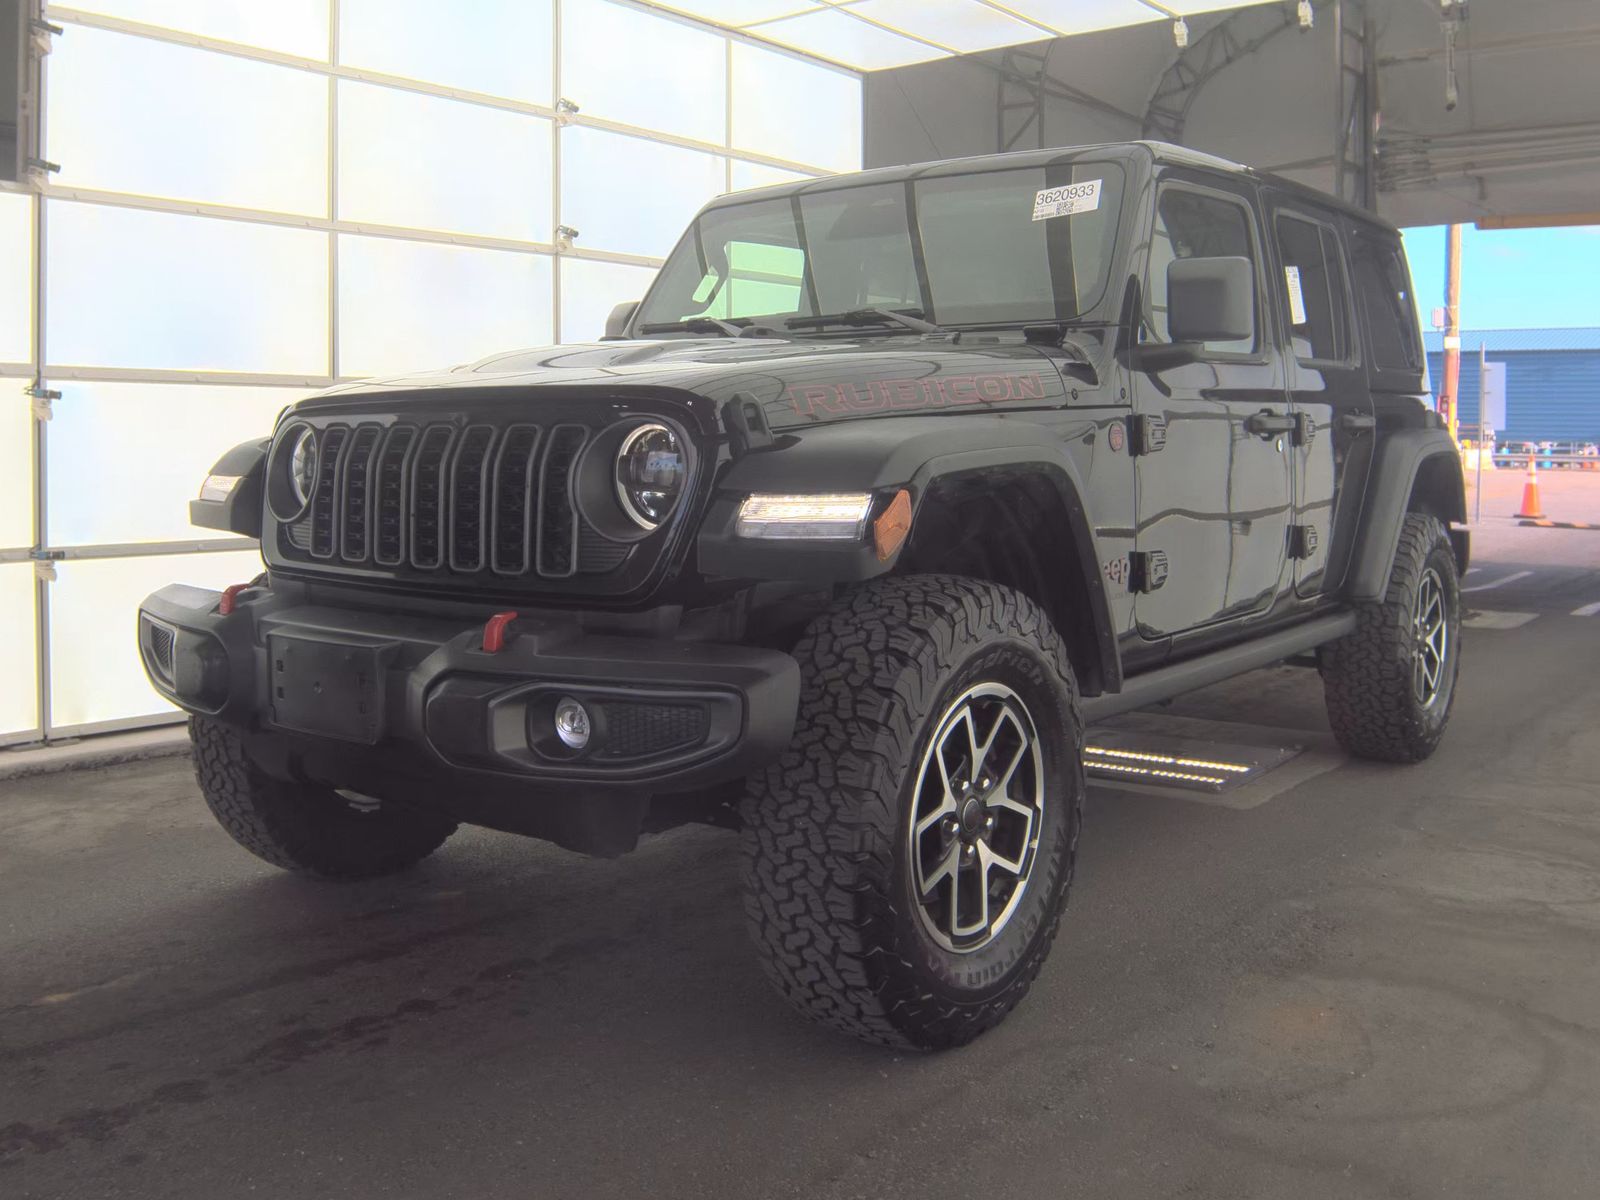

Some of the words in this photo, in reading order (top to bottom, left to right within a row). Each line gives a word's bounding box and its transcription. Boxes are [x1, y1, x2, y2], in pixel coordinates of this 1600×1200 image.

[1036, 184, 1094, 205] 3620933
[787, 372, 1046, 416] RUBICON
[1103, 557, 1130, 585] eep
